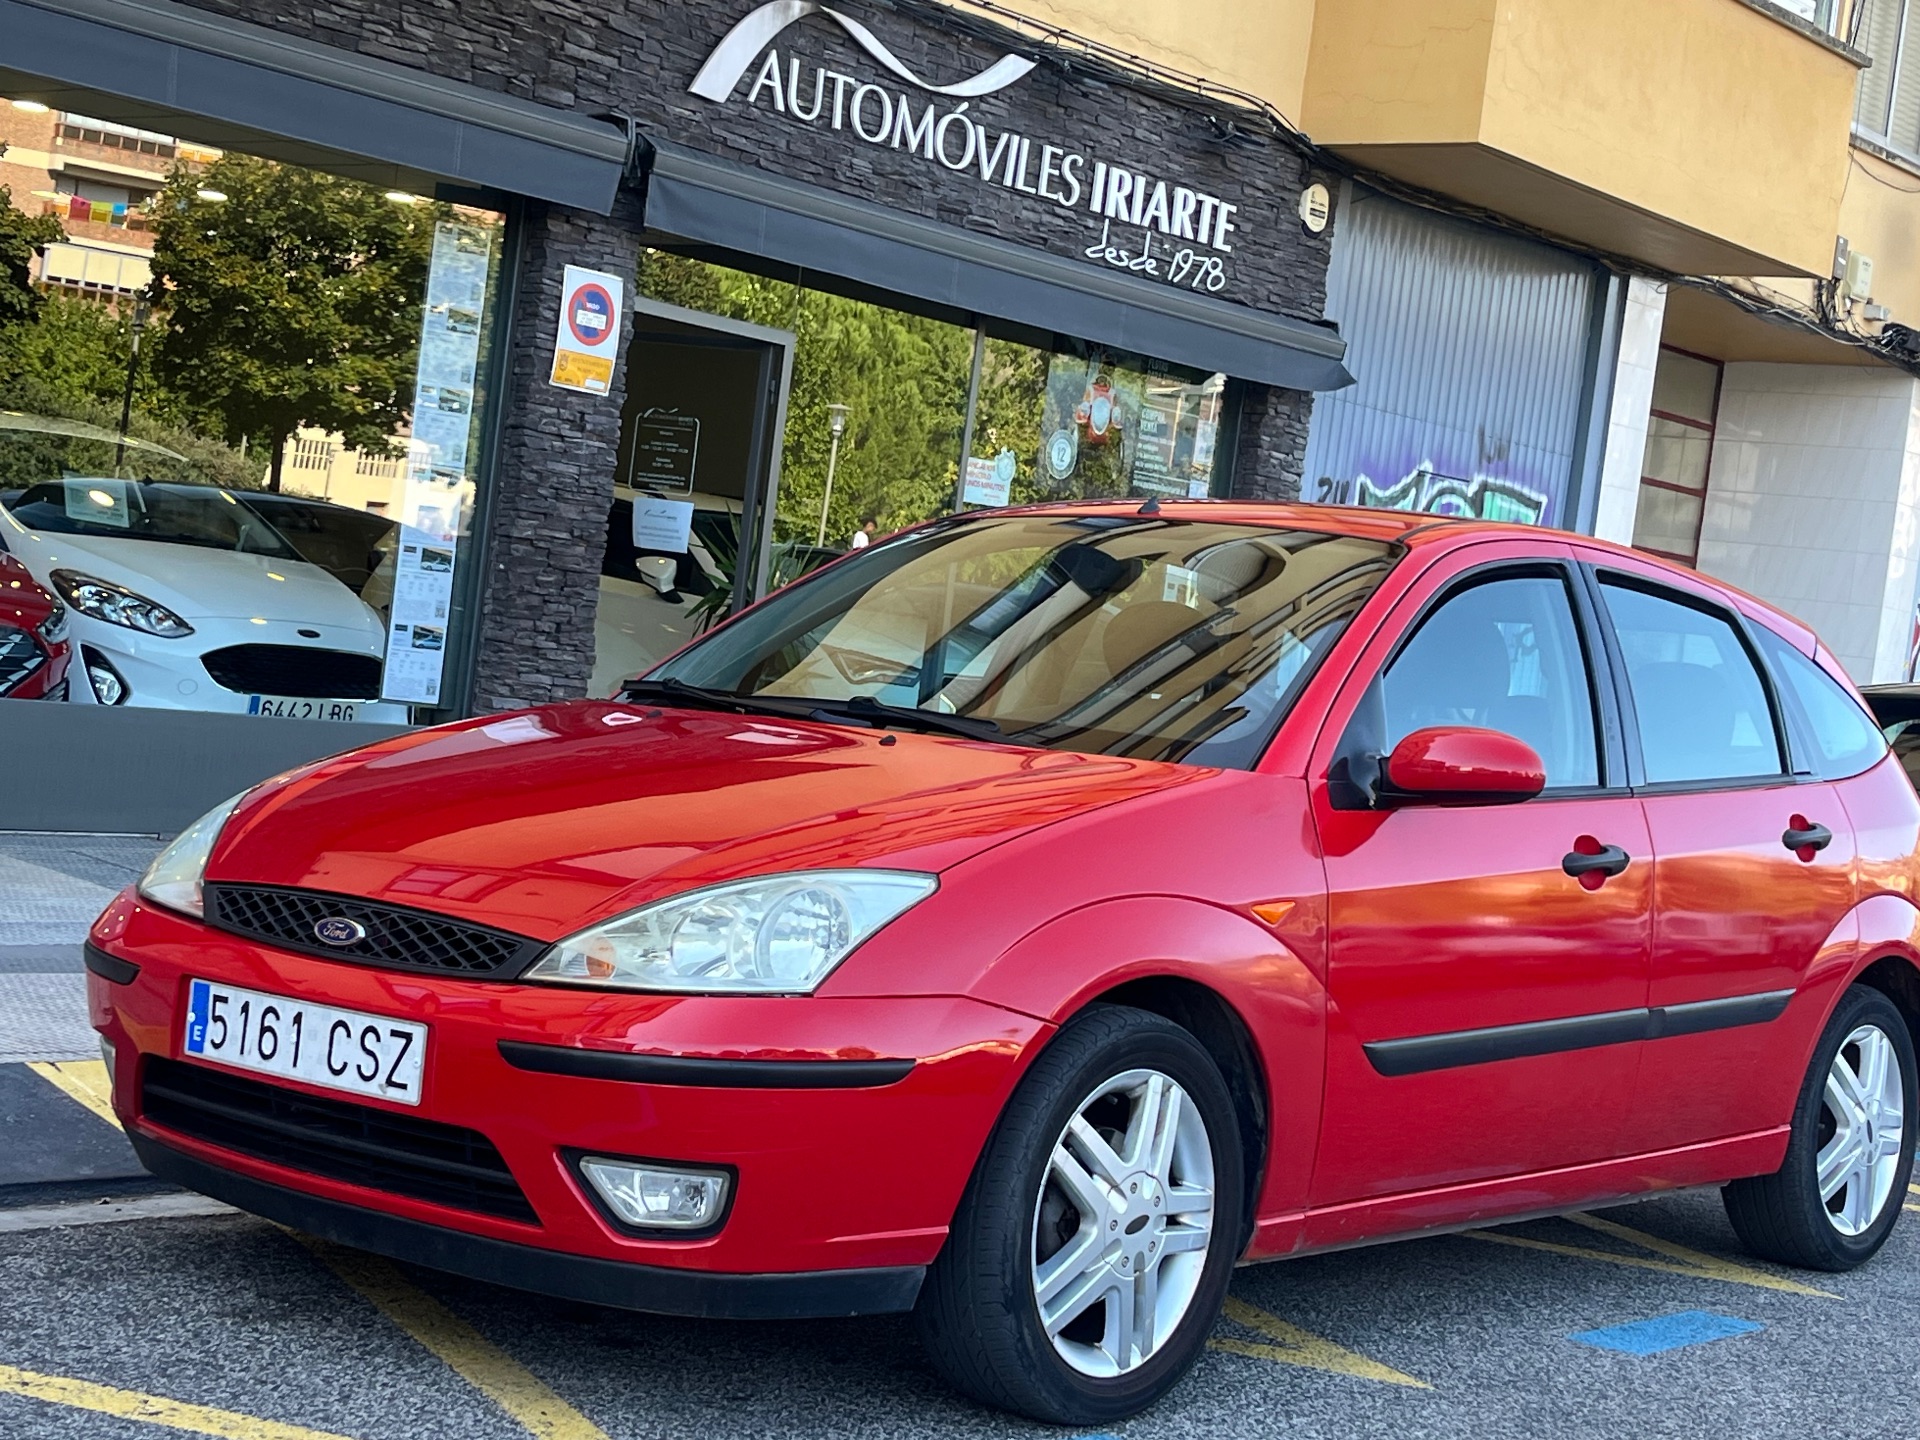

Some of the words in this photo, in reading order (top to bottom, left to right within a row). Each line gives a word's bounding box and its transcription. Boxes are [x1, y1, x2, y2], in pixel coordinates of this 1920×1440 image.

[747, 48, 1084, 208] AUTOMÓVILES
[1089, 162, 1238, 253] IRIARTE
[1085, 218, 1160, 276] desde
[1167, 249, 1226, 292] 1978
[261, 700, 312, 719] 6442
[323, 922, 349, 939] Ford
[210, 993, 303, 1068] 5161
[326, 1019, 414, 1091] CSZ
